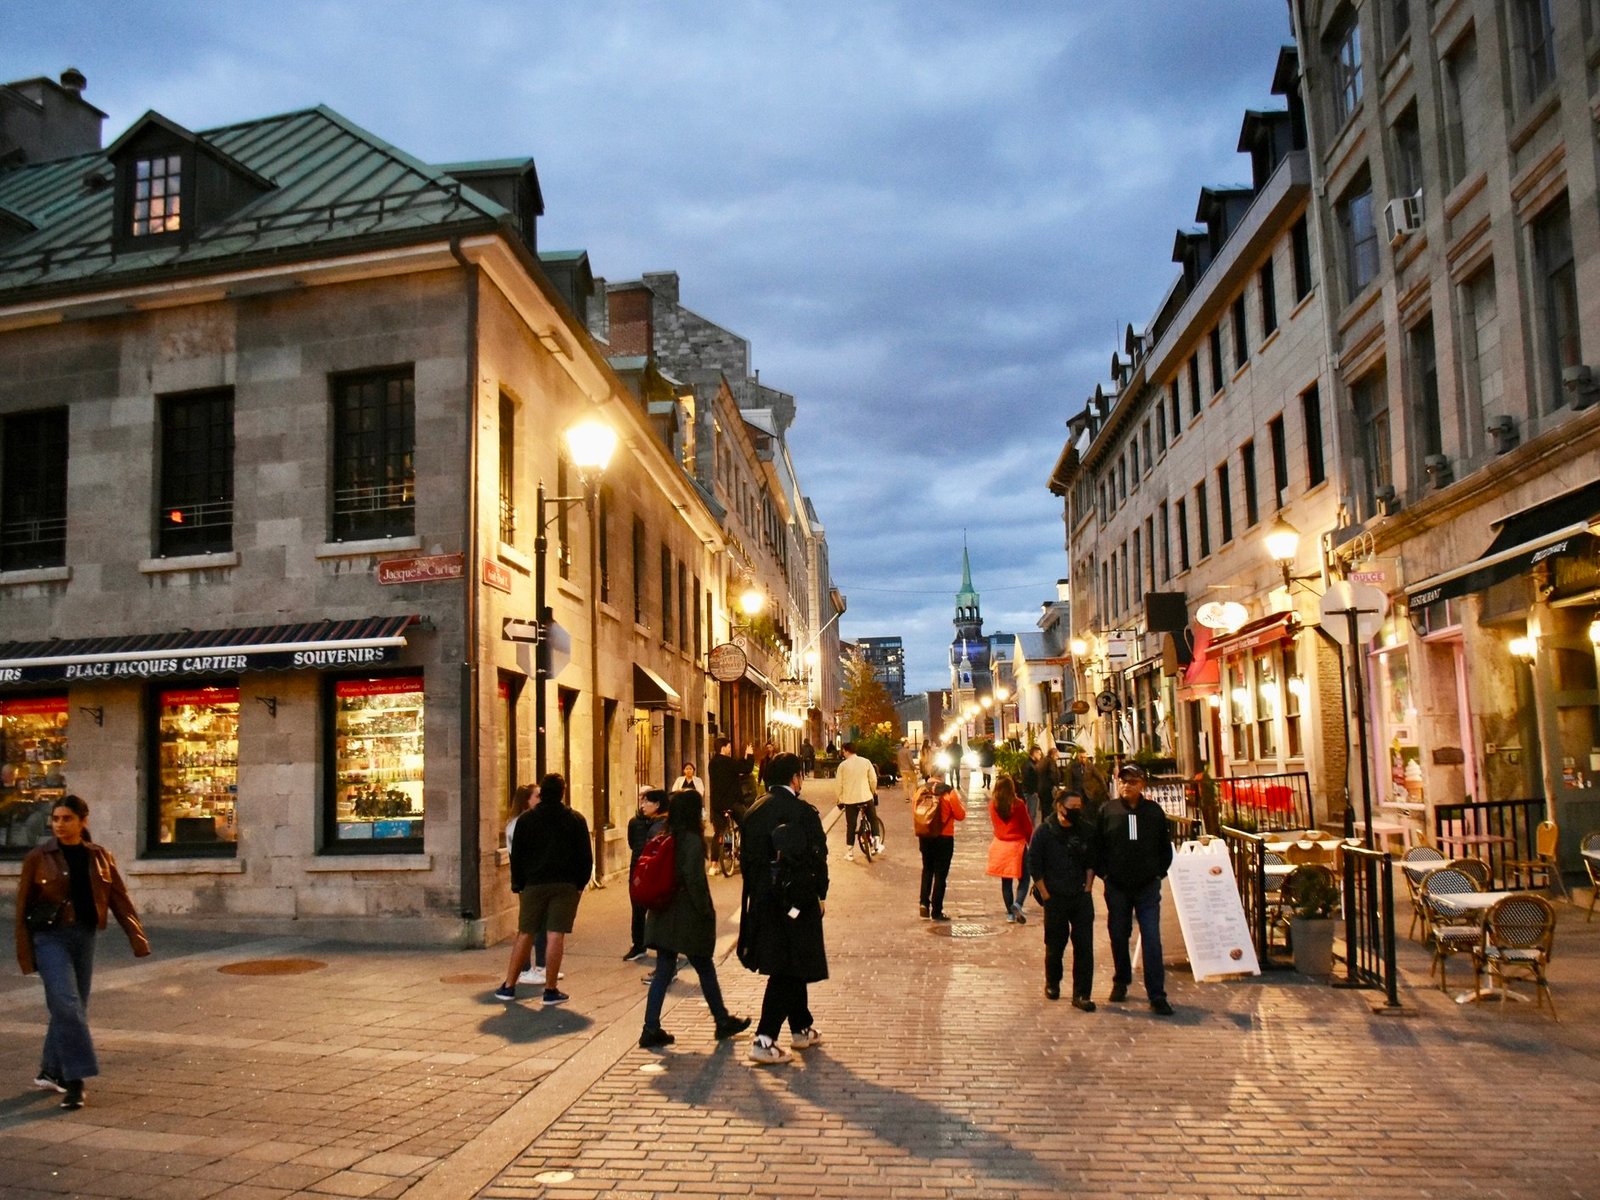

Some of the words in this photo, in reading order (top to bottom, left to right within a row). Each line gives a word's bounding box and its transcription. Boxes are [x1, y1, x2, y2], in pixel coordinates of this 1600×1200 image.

[1353, 573, 1383, 582] DULCE
[1410, 588, 1442, 607] RESTAURANT
[293, 647, 385, 665] SOUVENIRS
[66, 662, 111, 678] PLACE
[114, 658, 178, 676] JACQUES
[182, 654, 248, 671] CARTIER
